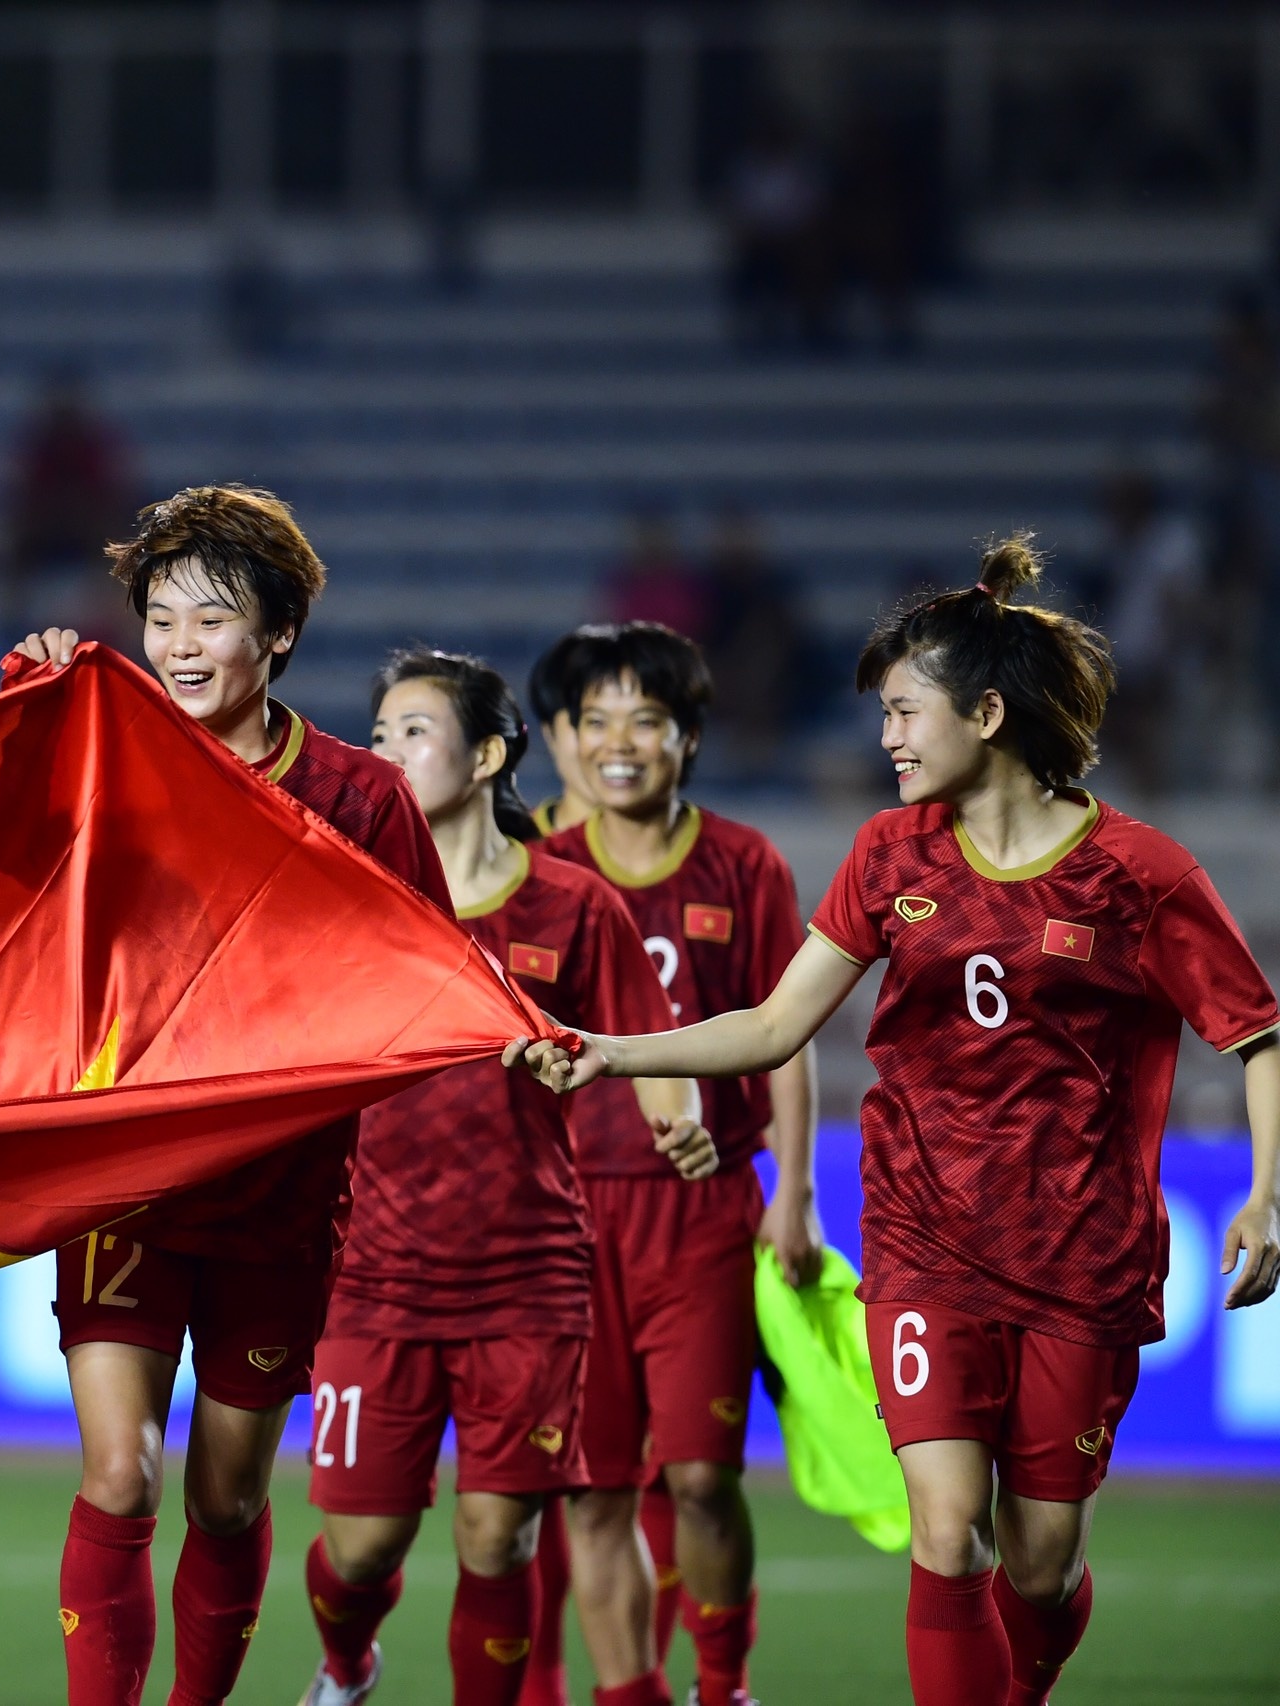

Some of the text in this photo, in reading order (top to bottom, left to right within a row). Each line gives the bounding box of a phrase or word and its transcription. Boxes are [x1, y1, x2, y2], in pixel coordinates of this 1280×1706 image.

[964, 953, 1009, 1029] 6
[80, 1230, 143, 1309] 12
[892, 1310, 930, 1397] 6
[314, 1381, 362, 1469] 21
